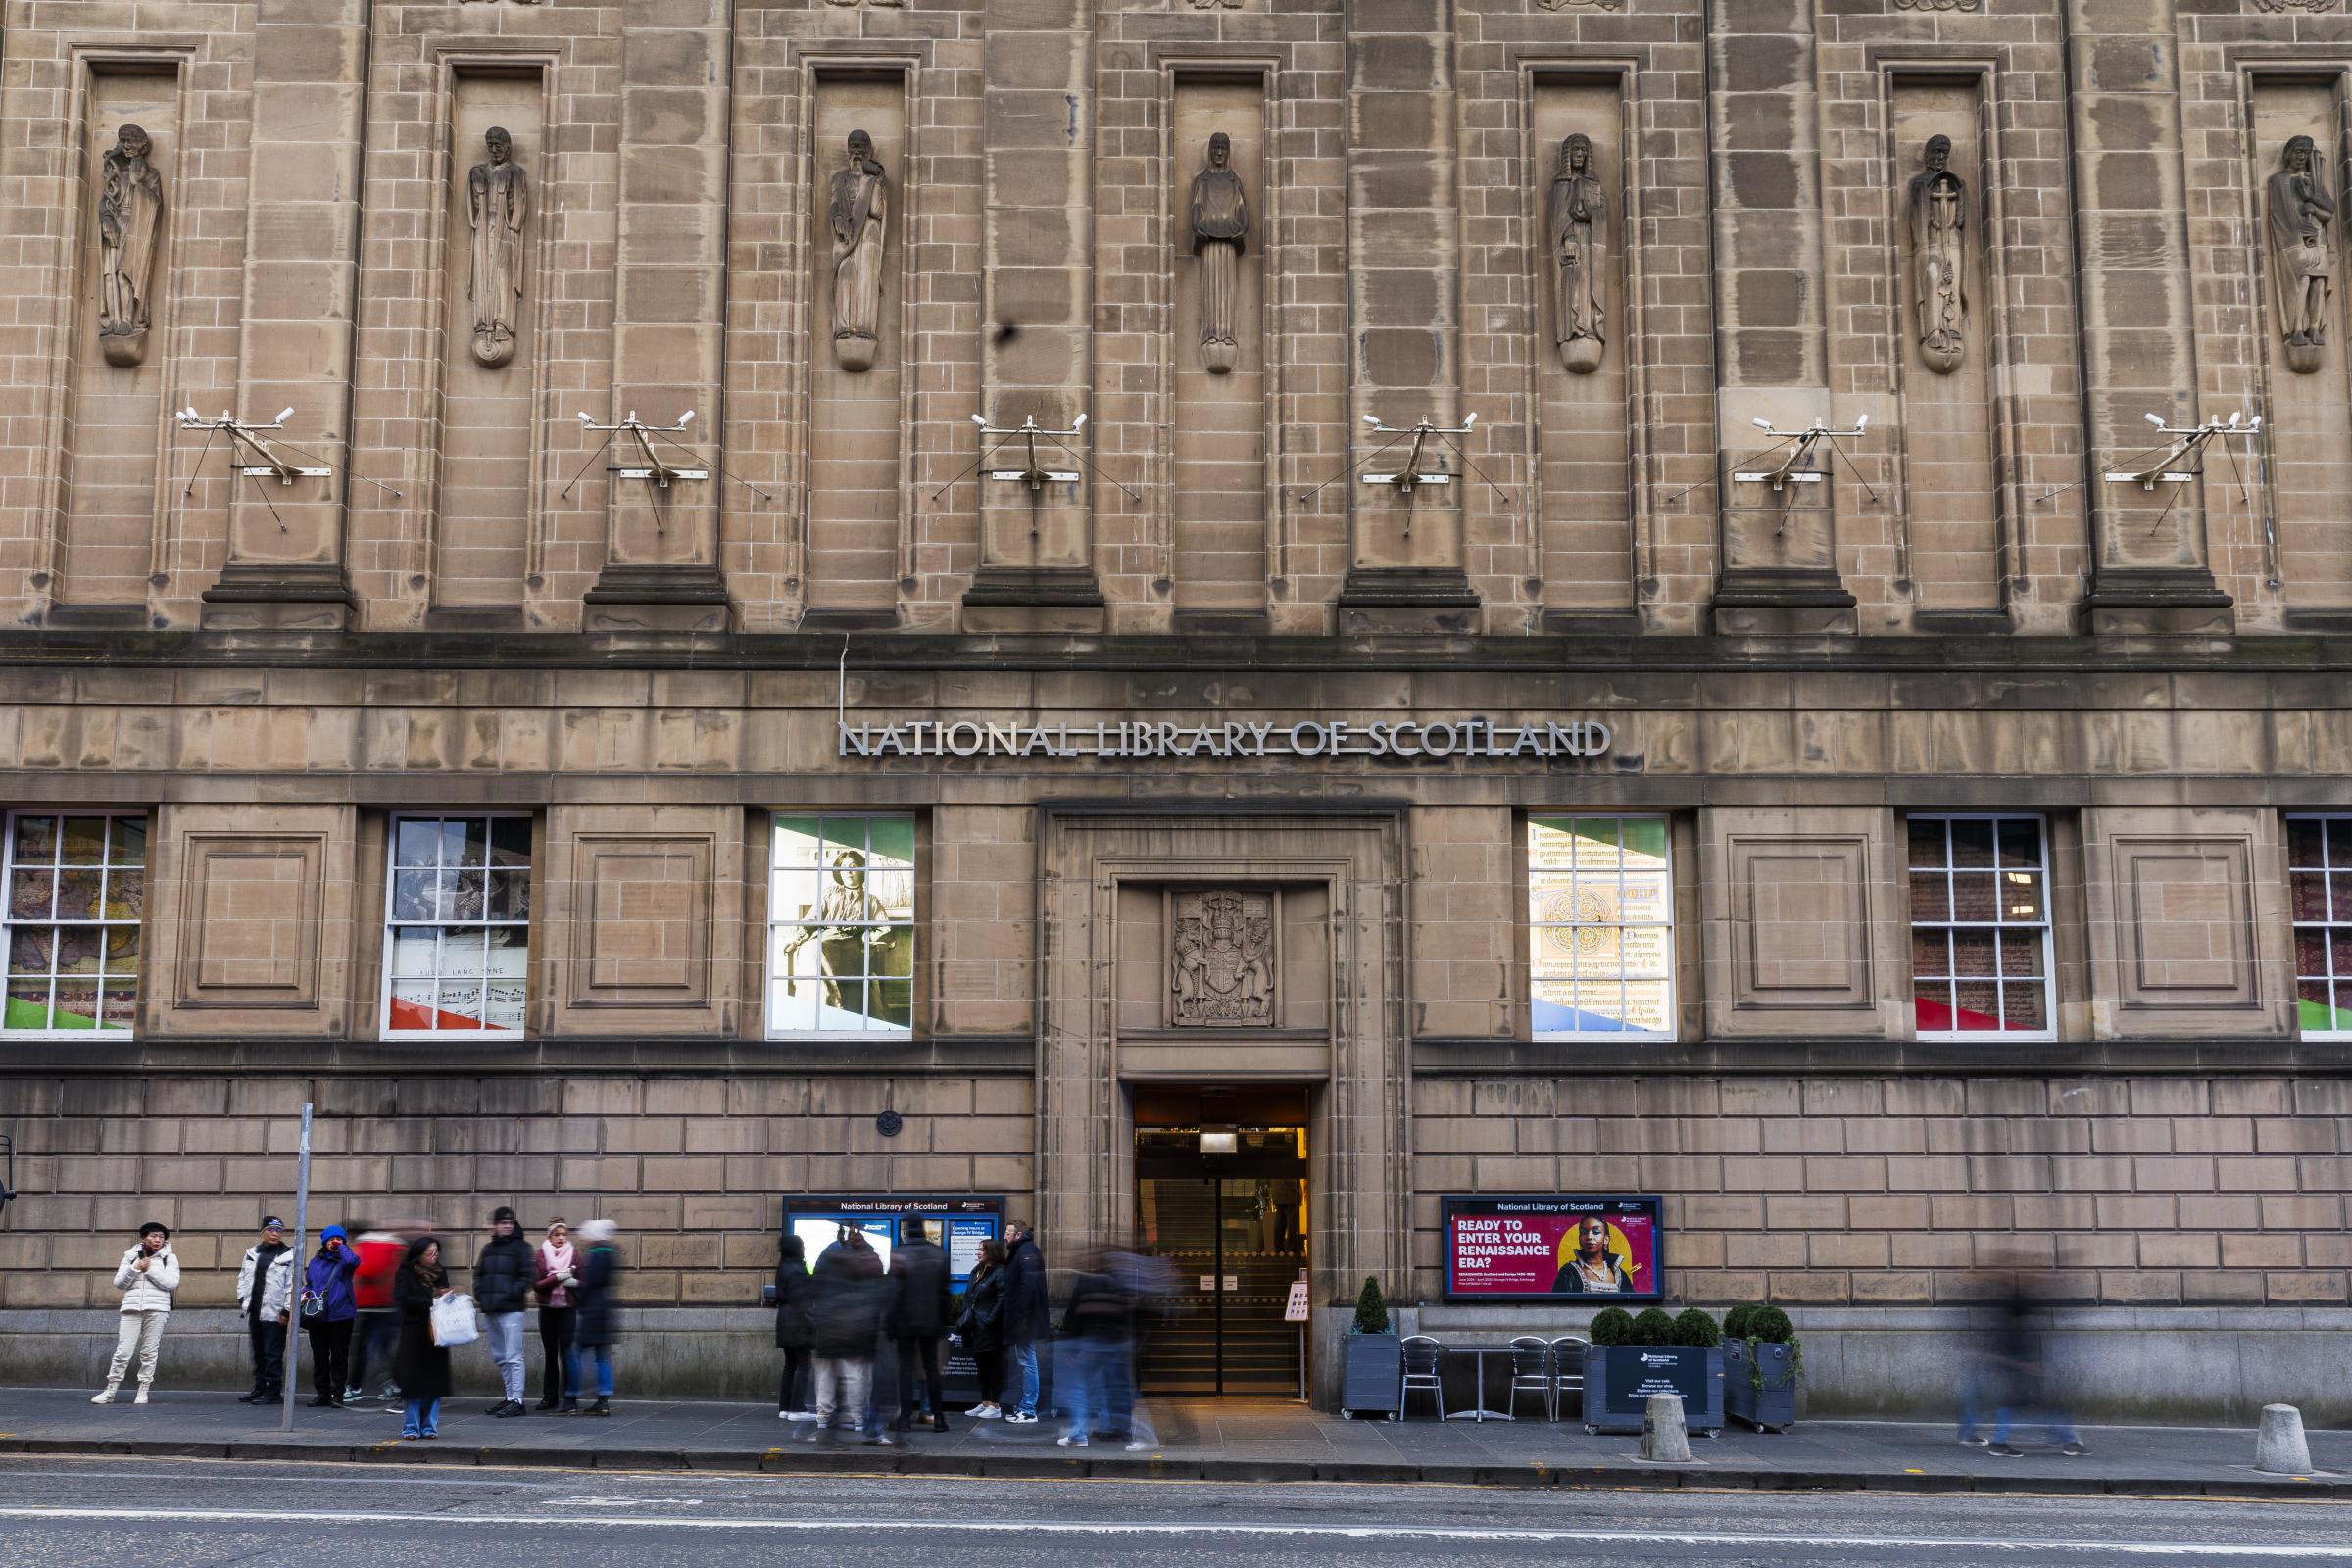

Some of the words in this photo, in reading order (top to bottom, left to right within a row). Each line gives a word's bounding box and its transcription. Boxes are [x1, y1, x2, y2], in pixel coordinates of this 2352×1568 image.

[838, 721, 1078, 756] NATIONAL
[1097, 721, 1273, 756] LIBRARY
[1290, 720, 1349, 756] OF
[1368, 721, 1612, 757] SCOTLAND
[875, 1202, 902, 1212] Library
[1532, 1203, 1558, 1212] Library
[1458, 1220, 1501, 1231] READY
[1504, 1220, 1523, 1231] TO
[1458, 1232, 1501, 1244] ENTER
[1504, 1232, 1542, 1244] YOUR
[1458, 1245, 1550, 1256] RENAISSANCE
[1458, 1257, 1492, 1269] ERA?
